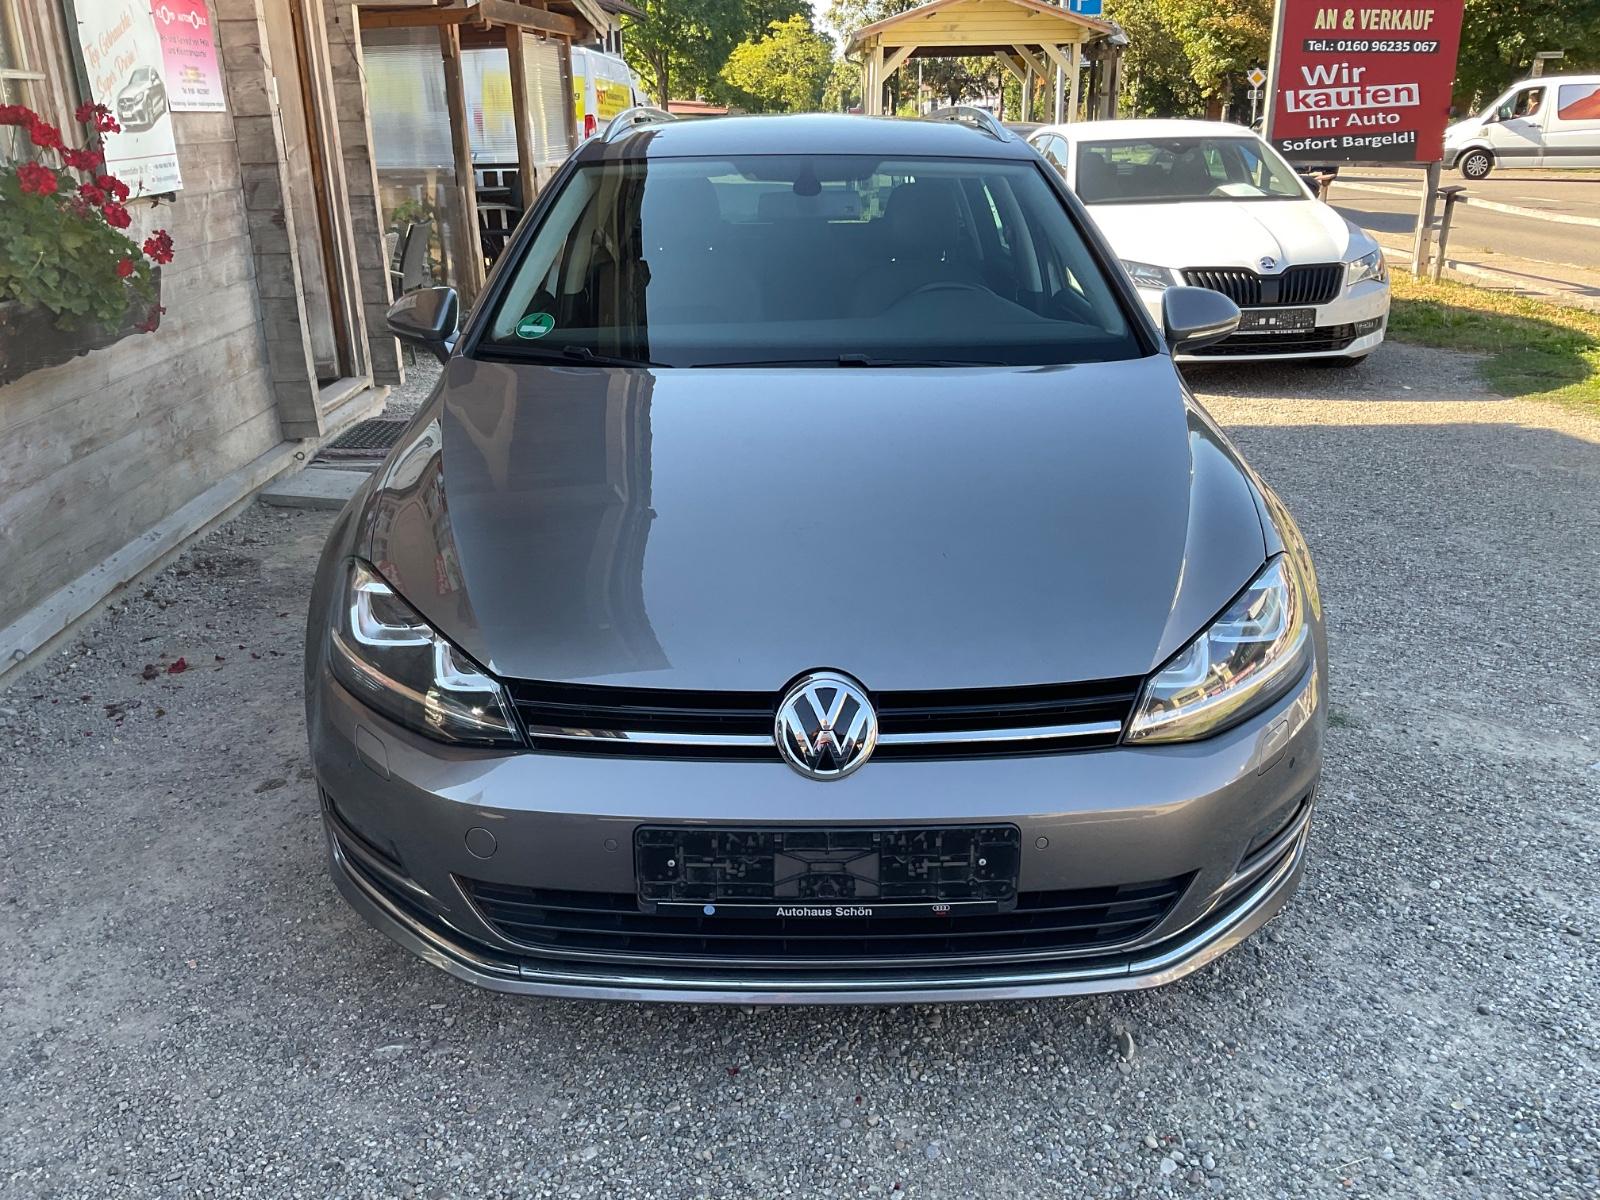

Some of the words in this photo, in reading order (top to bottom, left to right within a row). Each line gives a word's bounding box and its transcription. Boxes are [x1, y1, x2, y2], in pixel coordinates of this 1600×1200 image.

[1314, 9, 1338, 30] AN
[1342, 9, 1354, 30] &
[1360, 9, 1435, 31] VERKAUF
[1308, 40, 1334, 51] Tel.:
[1337, 40, 1369, 52] 0160
[1372, 40, 1410, 52] 96235
[1413, 41, 1437, 52] 067
[1301, 62, 1366, 86] Wir
[1293, 86, 1414, 110] kaufen
[1309, 115, 1340, 129] Ihr
[1346, 112, 1401, 127] Auto
[1282, 137, 1338, 152] Sofort
[1343, 131, 1415, 148] Bargeld!
[776, 907, 833, 917] Autohaus
[835, 907, 873, 917] Schön
